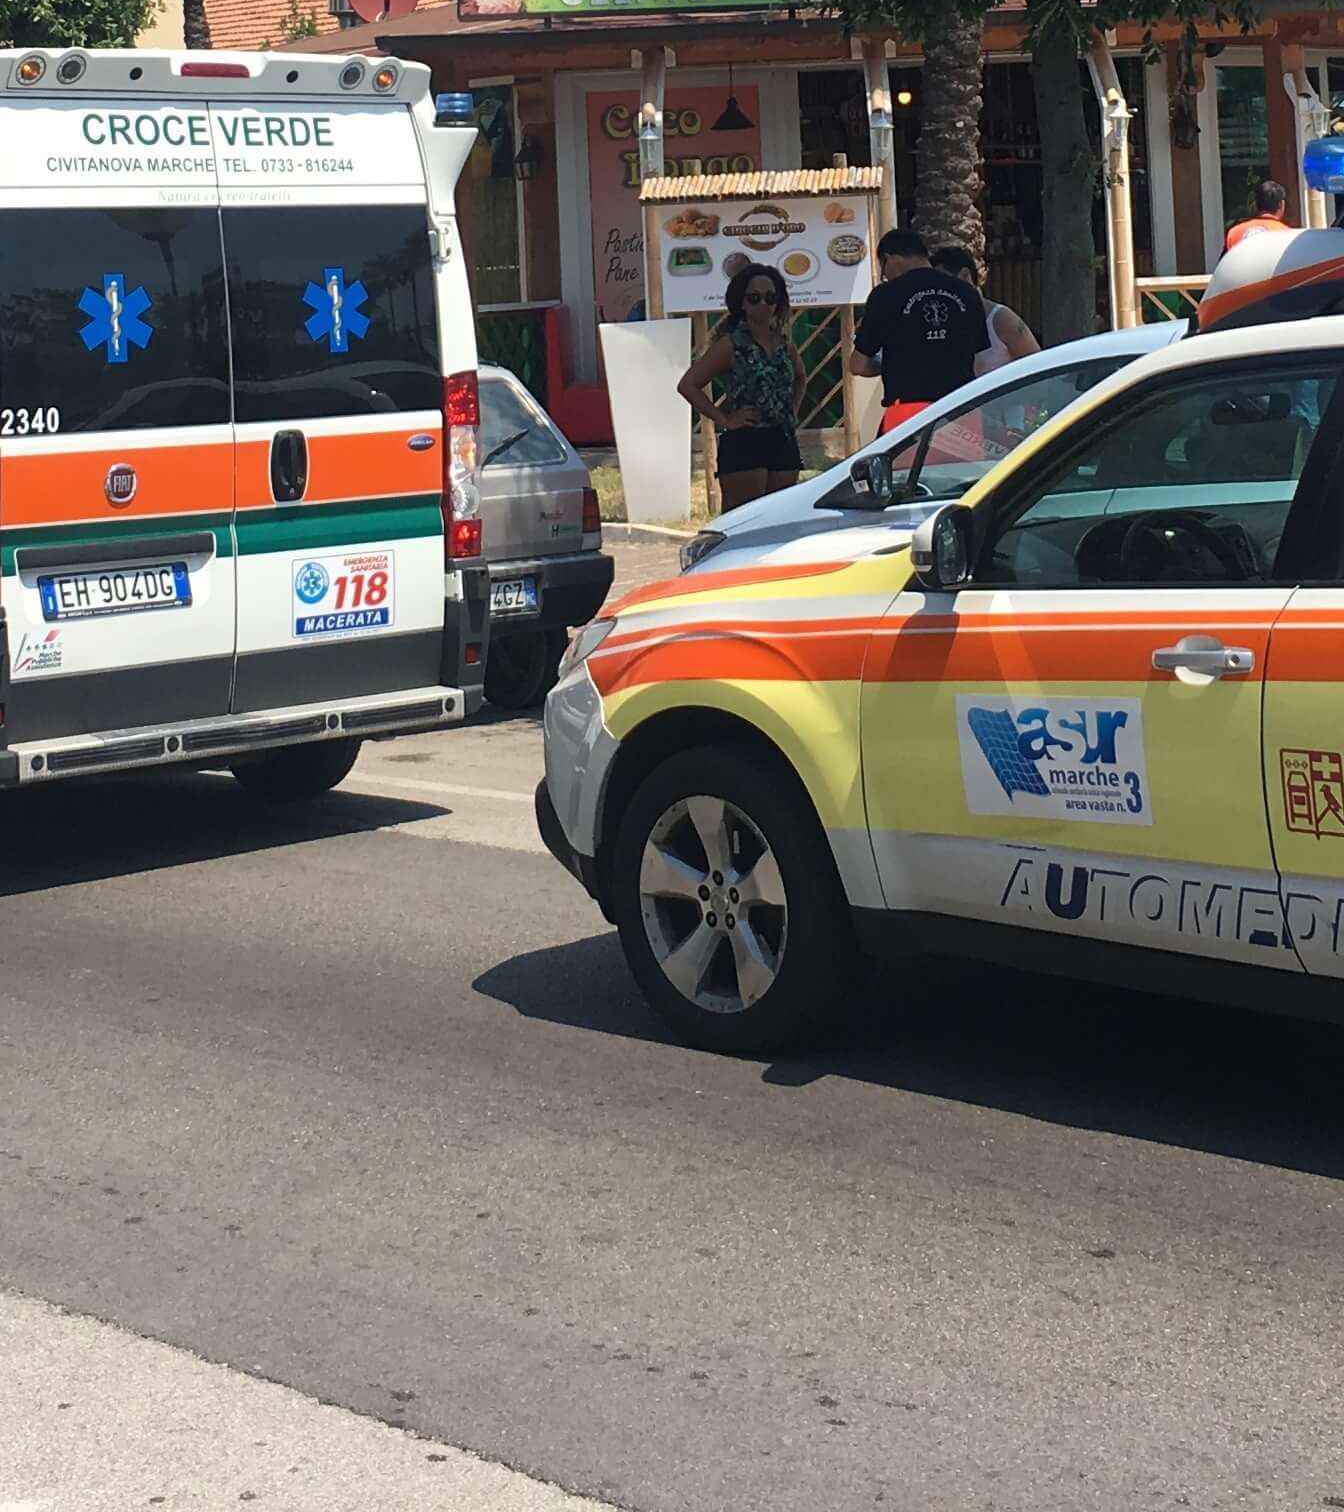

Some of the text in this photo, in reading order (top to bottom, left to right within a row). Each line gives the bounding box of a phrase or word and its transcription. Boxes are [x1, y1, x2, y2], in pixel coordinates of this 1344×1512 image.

[82, 113, 334, 146] CROCE VERDE
[604, 104, 702, 138] Cco
[47, 157, 144, 173] CIVITANOVA
[148, 158, 216, 173] MARCHE
[606, 256, 639, 283] Pane
[0, 407, 60, 435] 2340
[113, 475, 132, 493] FIAT
[59, 570, 173, 608] EH 904DG
[334, 571, 388, 610] 118
[303, 610, 382, 632] MACERATA
[1017, 707, 1129, 764] asur
[1049, 766, 1120, 787] marche
[1065, 800, 1087, 810] area
[1088, 801, 1116, 812] vasta
[1124, 771, 1143, 813] 3
